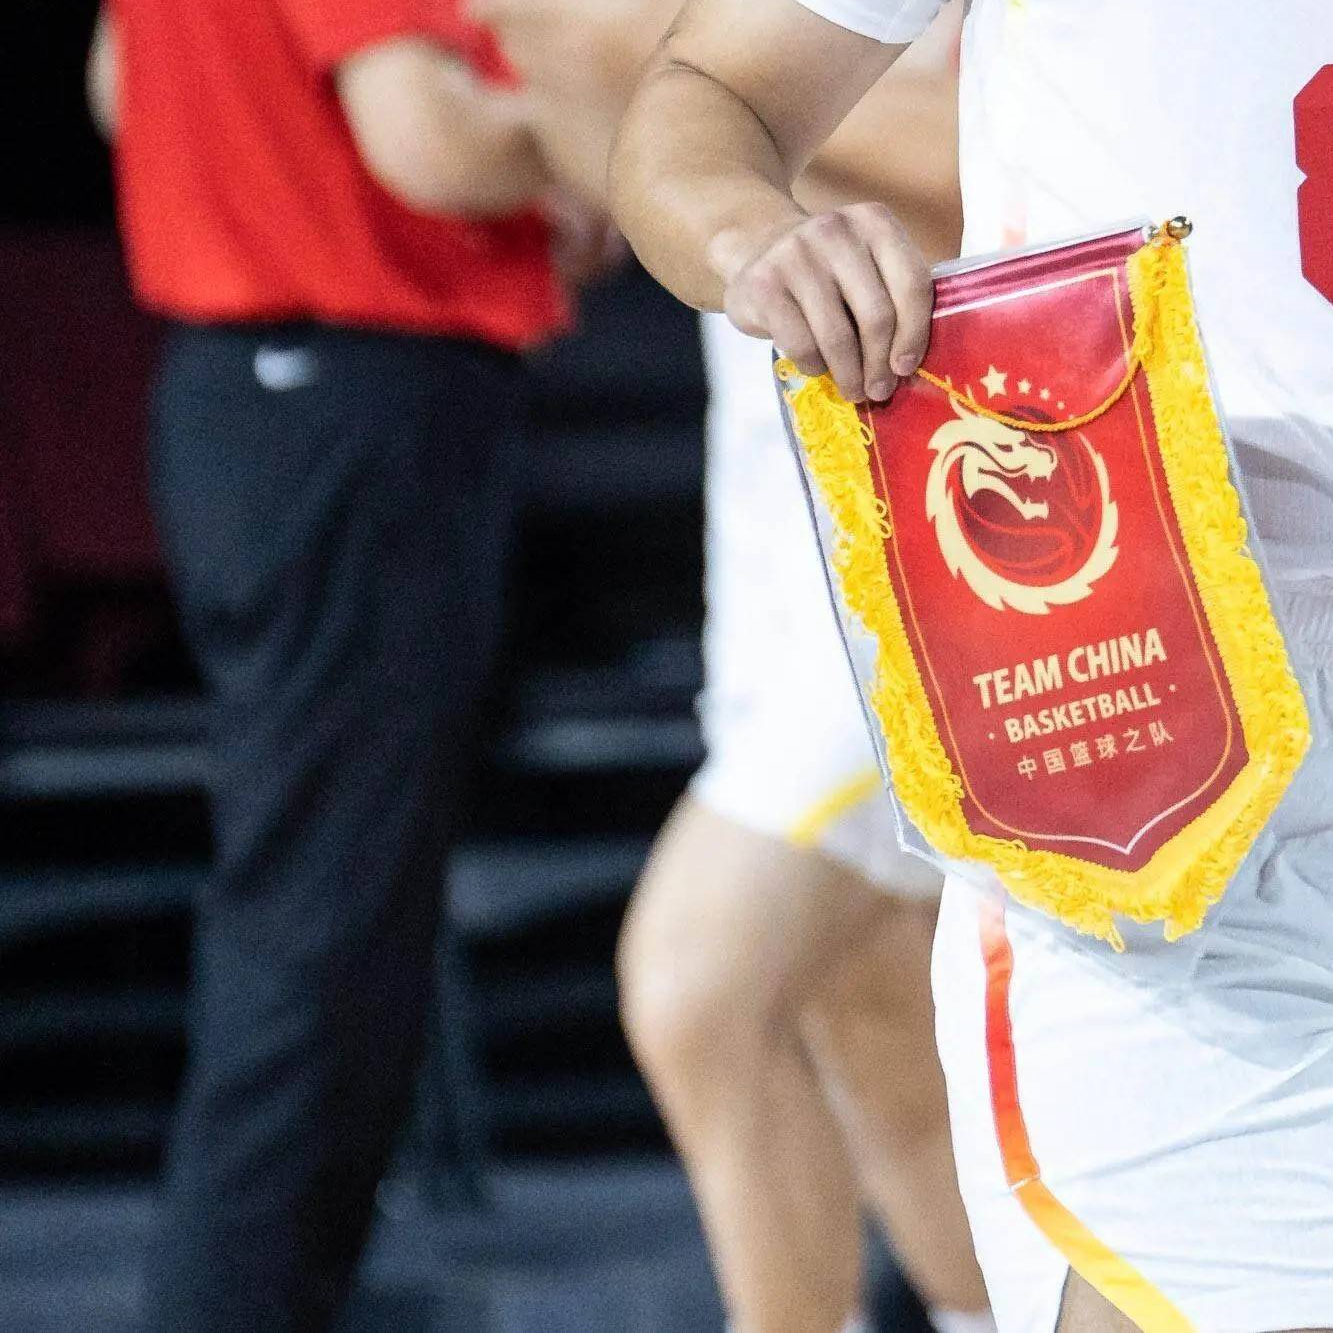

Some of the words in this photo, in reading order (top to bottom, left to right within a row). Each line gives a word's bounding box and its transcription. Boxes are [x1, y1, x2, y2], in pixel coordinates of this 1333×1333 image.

[972, 653, 1064, 709] TEAM
[1066, 627, 1168, 683] CHINA
[1004, 682, 1162, 743] BASKETBALL
[1016, 720, 1175, 781] 中国篮球之队
